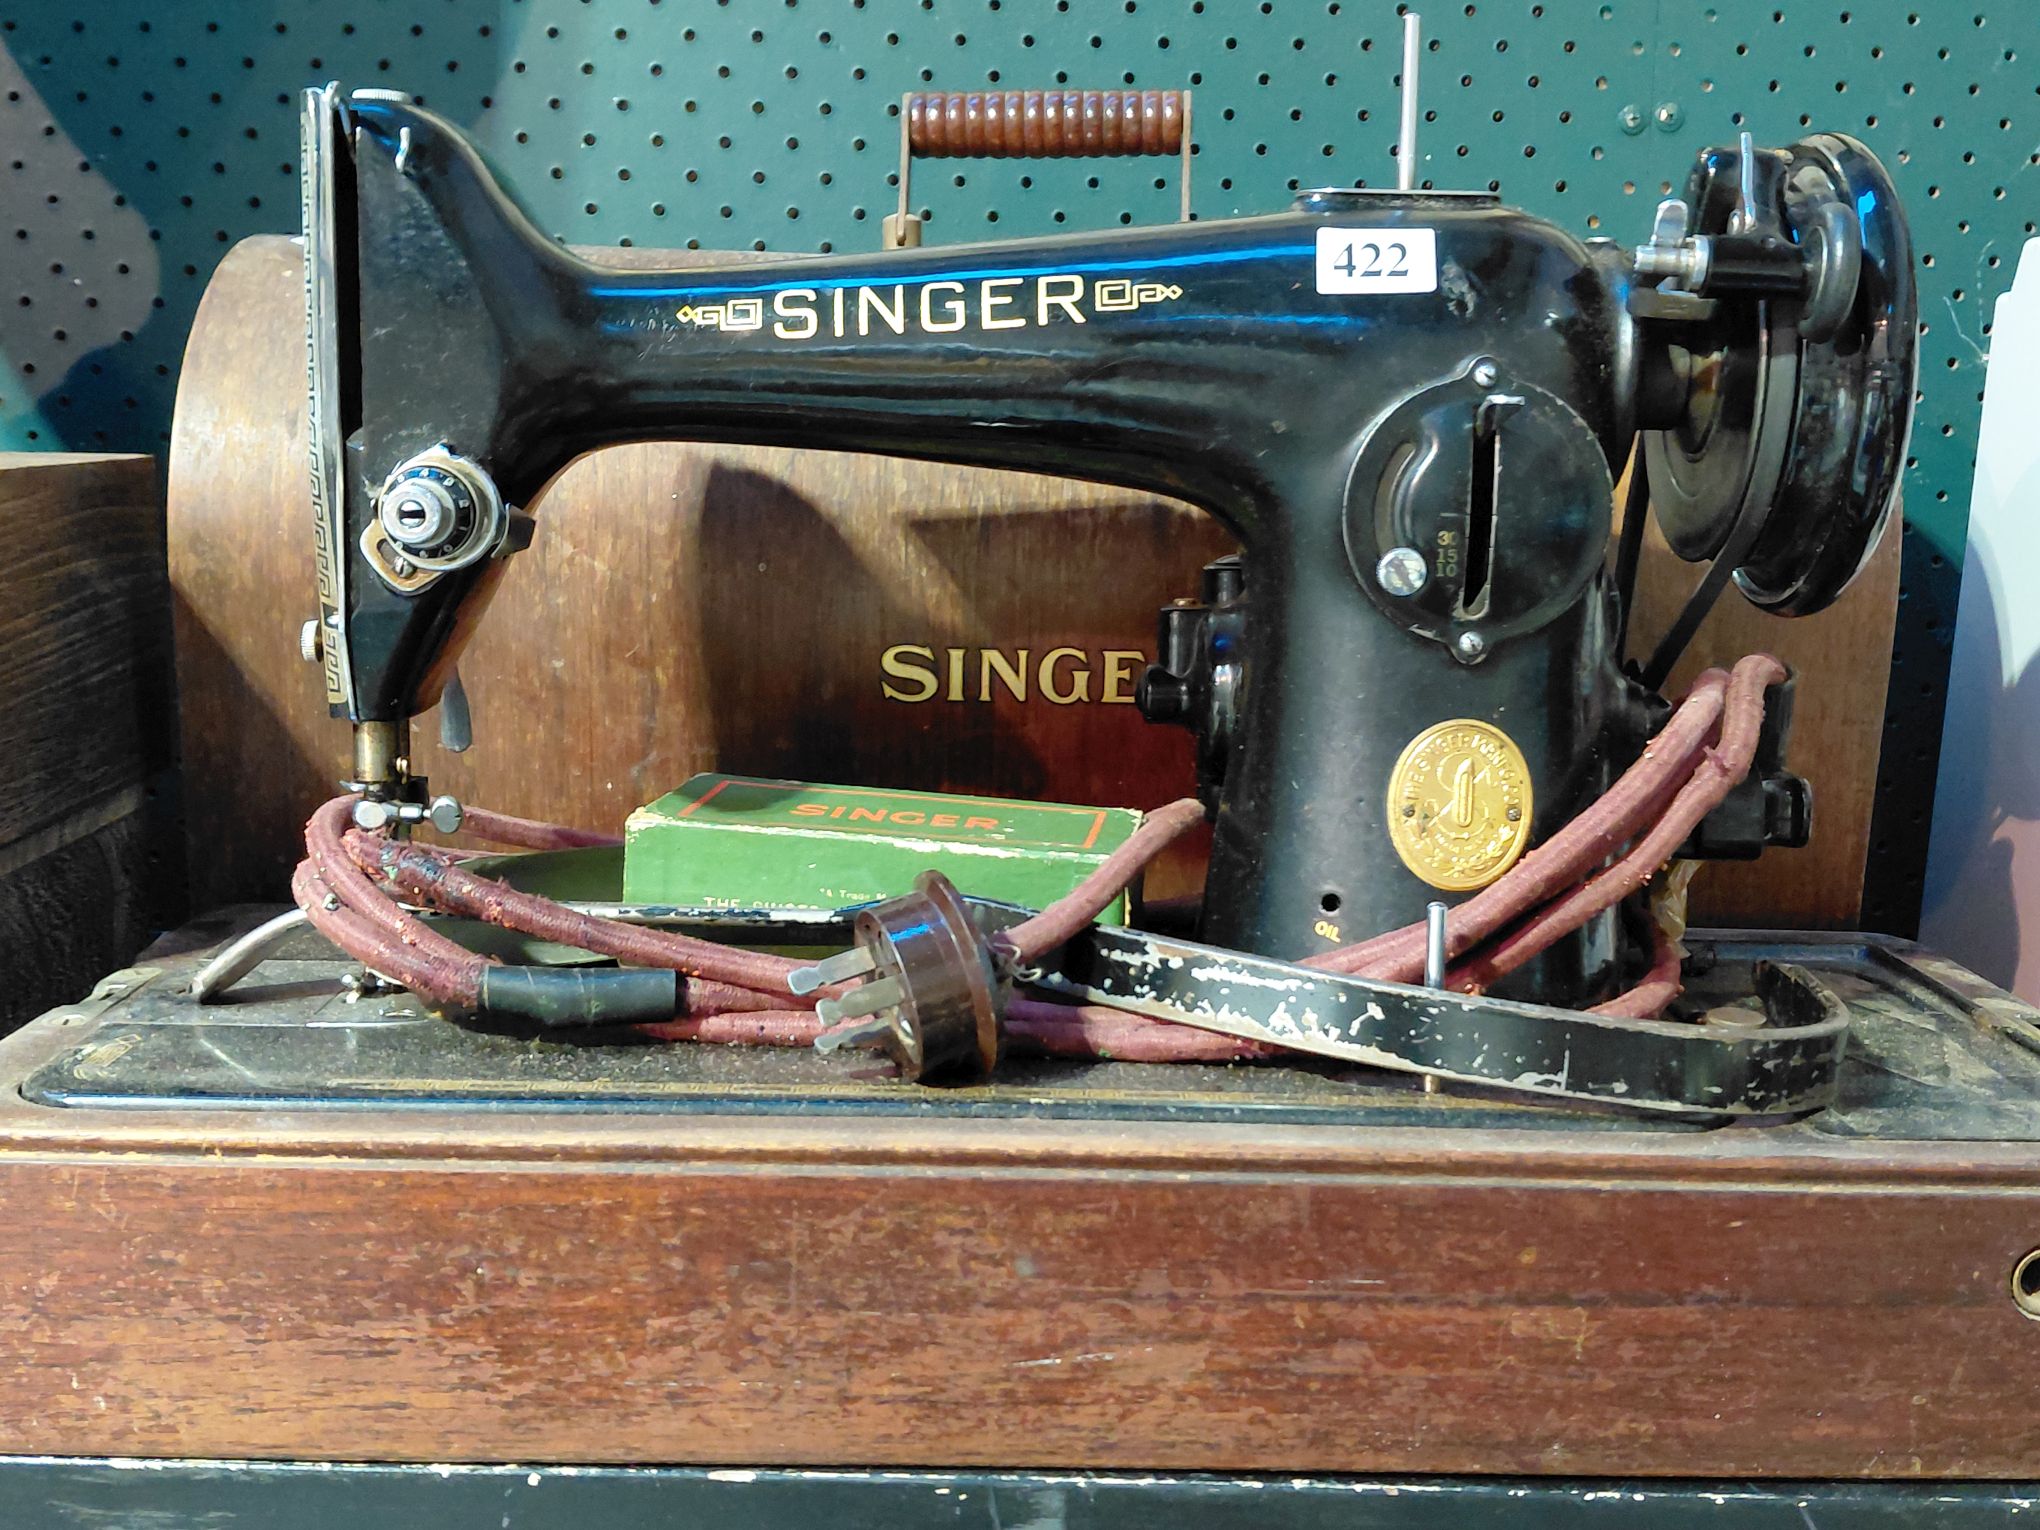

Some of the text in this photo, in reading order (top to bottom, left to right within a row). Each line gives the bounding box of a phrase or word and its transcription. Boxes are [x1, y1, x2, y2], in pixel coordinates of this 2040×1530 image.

[1333, 243, 1409, 277] 422
[773, 274, 1087, 340] SINGER
[1436, 562, 1457, 577] 10
[1437, 548, 1458, 563] 15
[880, 644, 1146, 705] SINGE
[790, 803, 999, 831] SINGER
[1313, 920, 1341, 943] OIL
